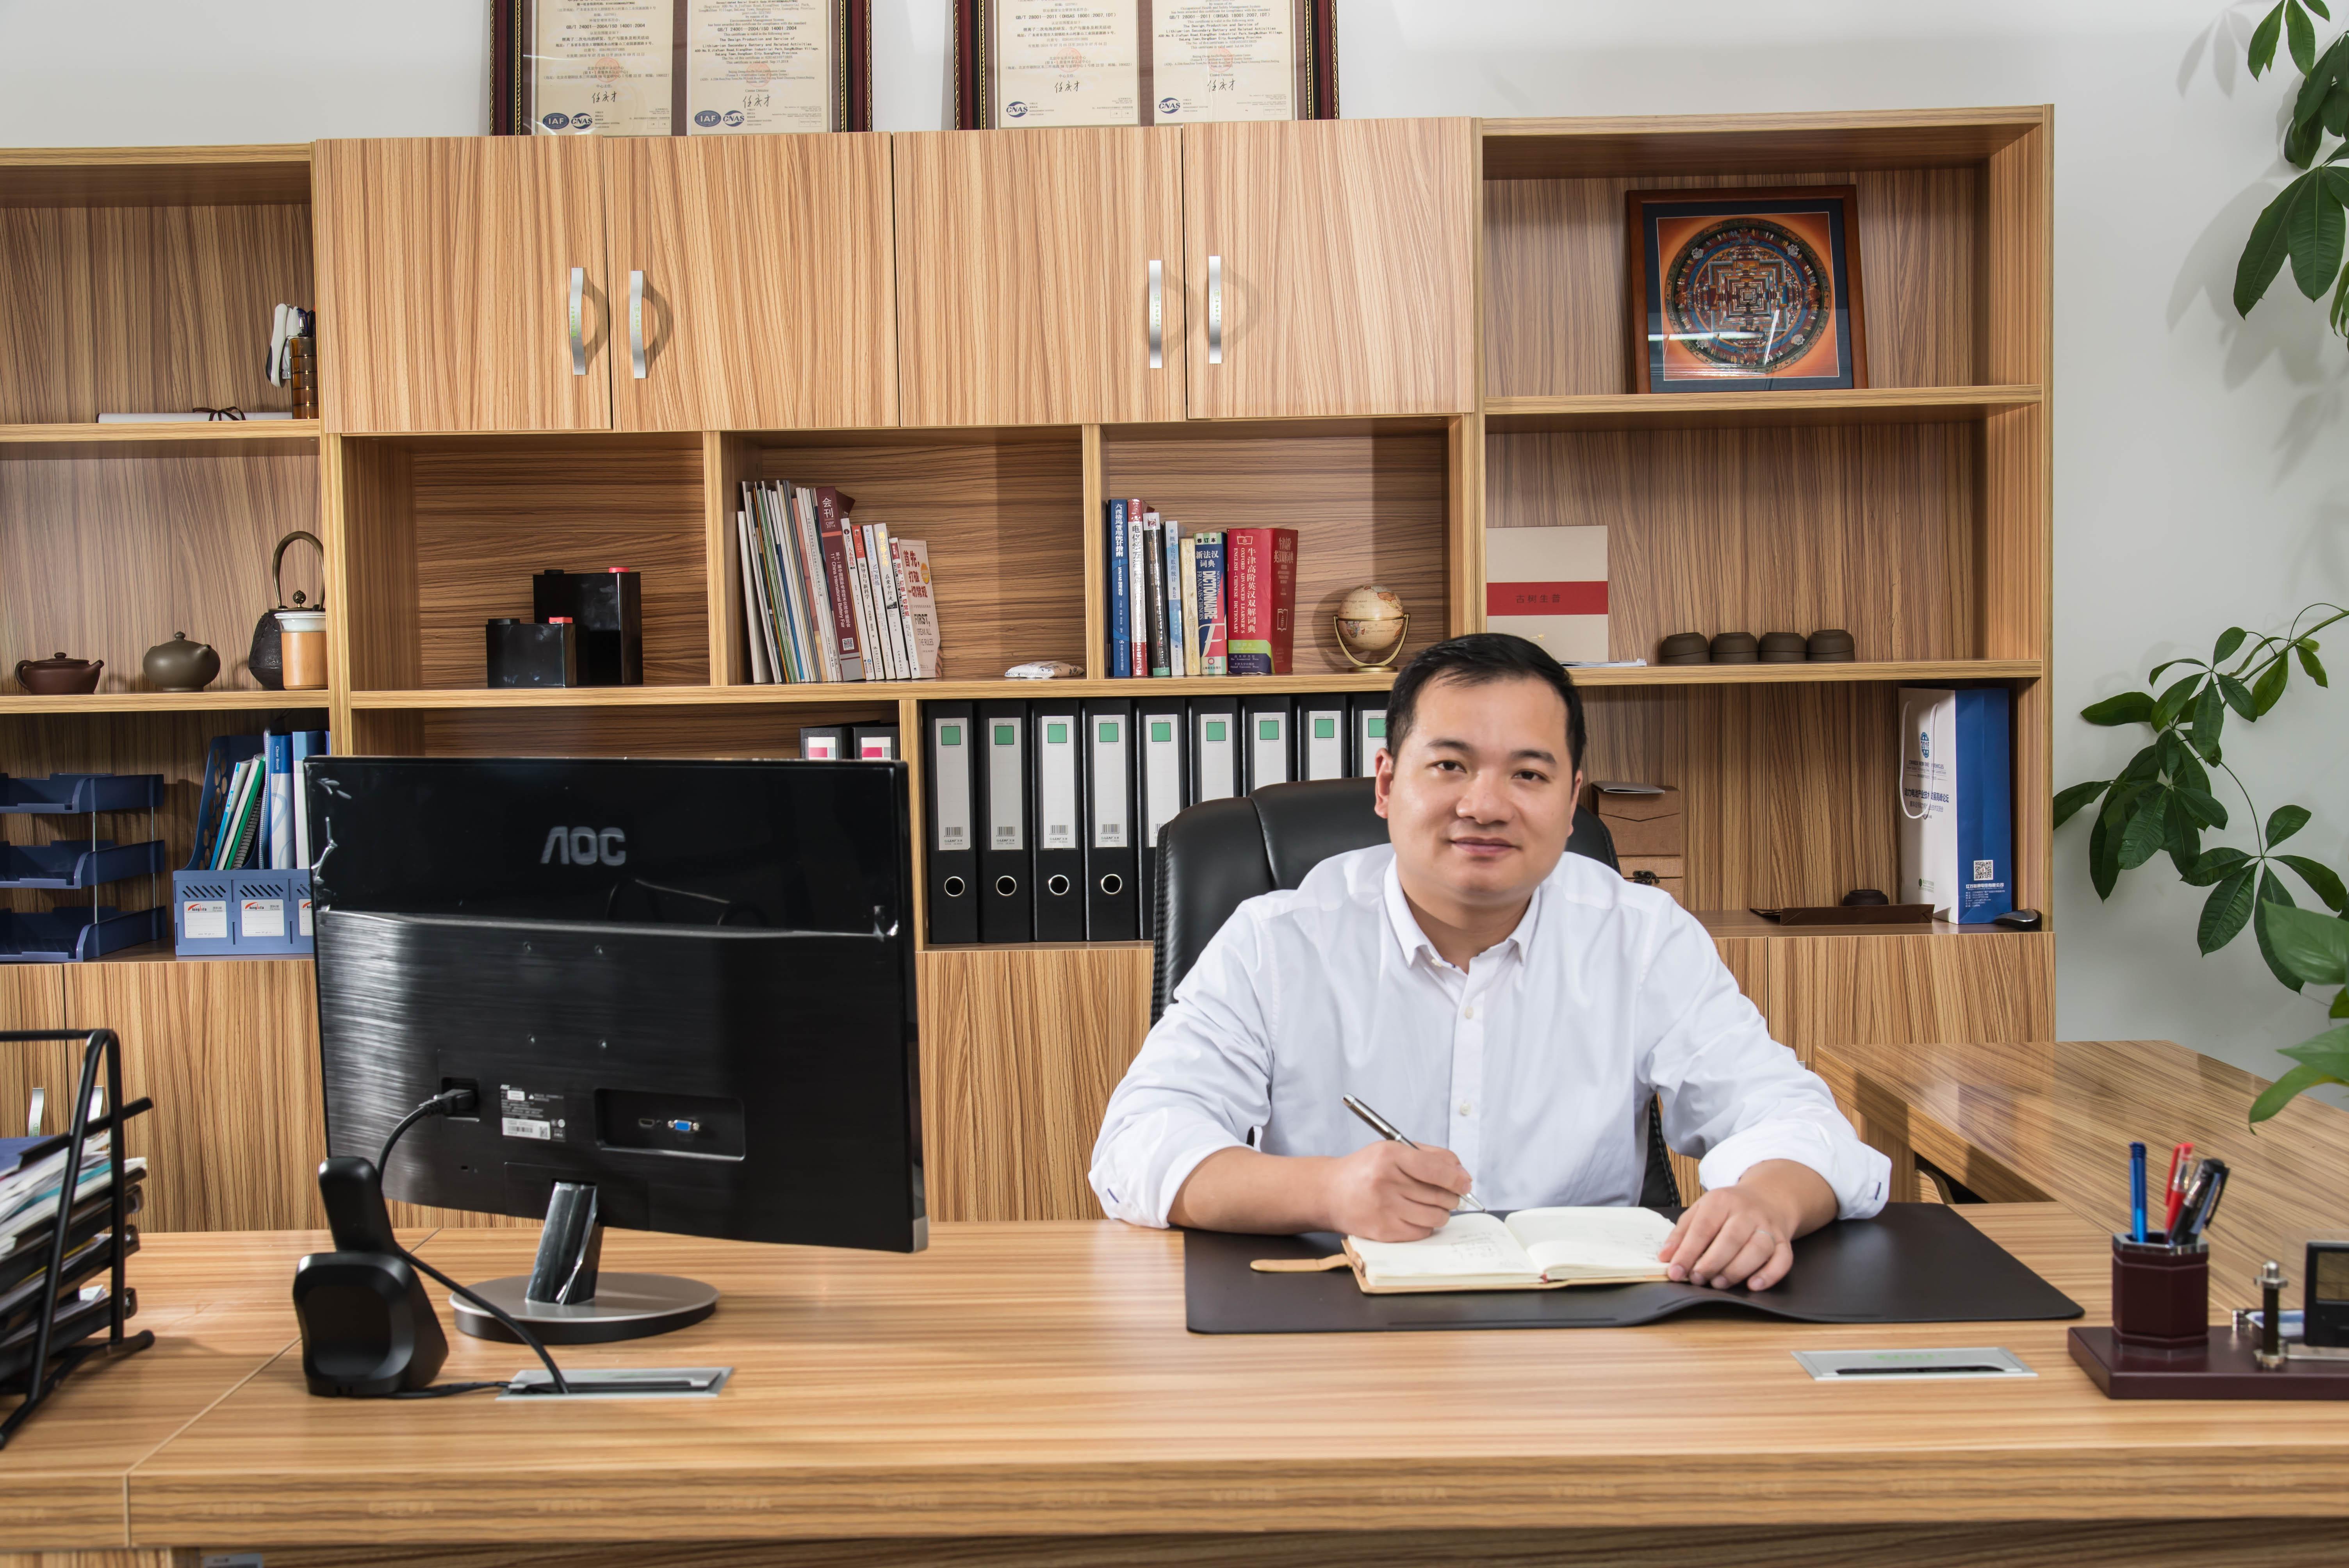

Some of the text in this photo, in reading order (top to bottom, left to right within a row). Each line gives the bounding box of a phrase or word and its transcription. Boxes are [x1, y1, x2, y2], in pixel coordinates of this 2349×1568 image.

[822, 497, 834, 518] 会刊
[1115, 504, 1123, 557] 六西格玛管理统计指南
[1196, 551, 1219, 559] 新法汉
[1200, 559, 1215, 568] 词典
[908, 570, 920, 583] 打破
[908, 586, 928, 598] 一切常规
[1203, 570, 1217, 620] DICTIONNAIRE
[1247, 547, 1256, 633] 牛津高阶英汉双解词典
[1516, 594, 1561, 604] 古树生普
[914, 614, 930, 627] FIRST,
[541, 826, 627, 865] AOC
